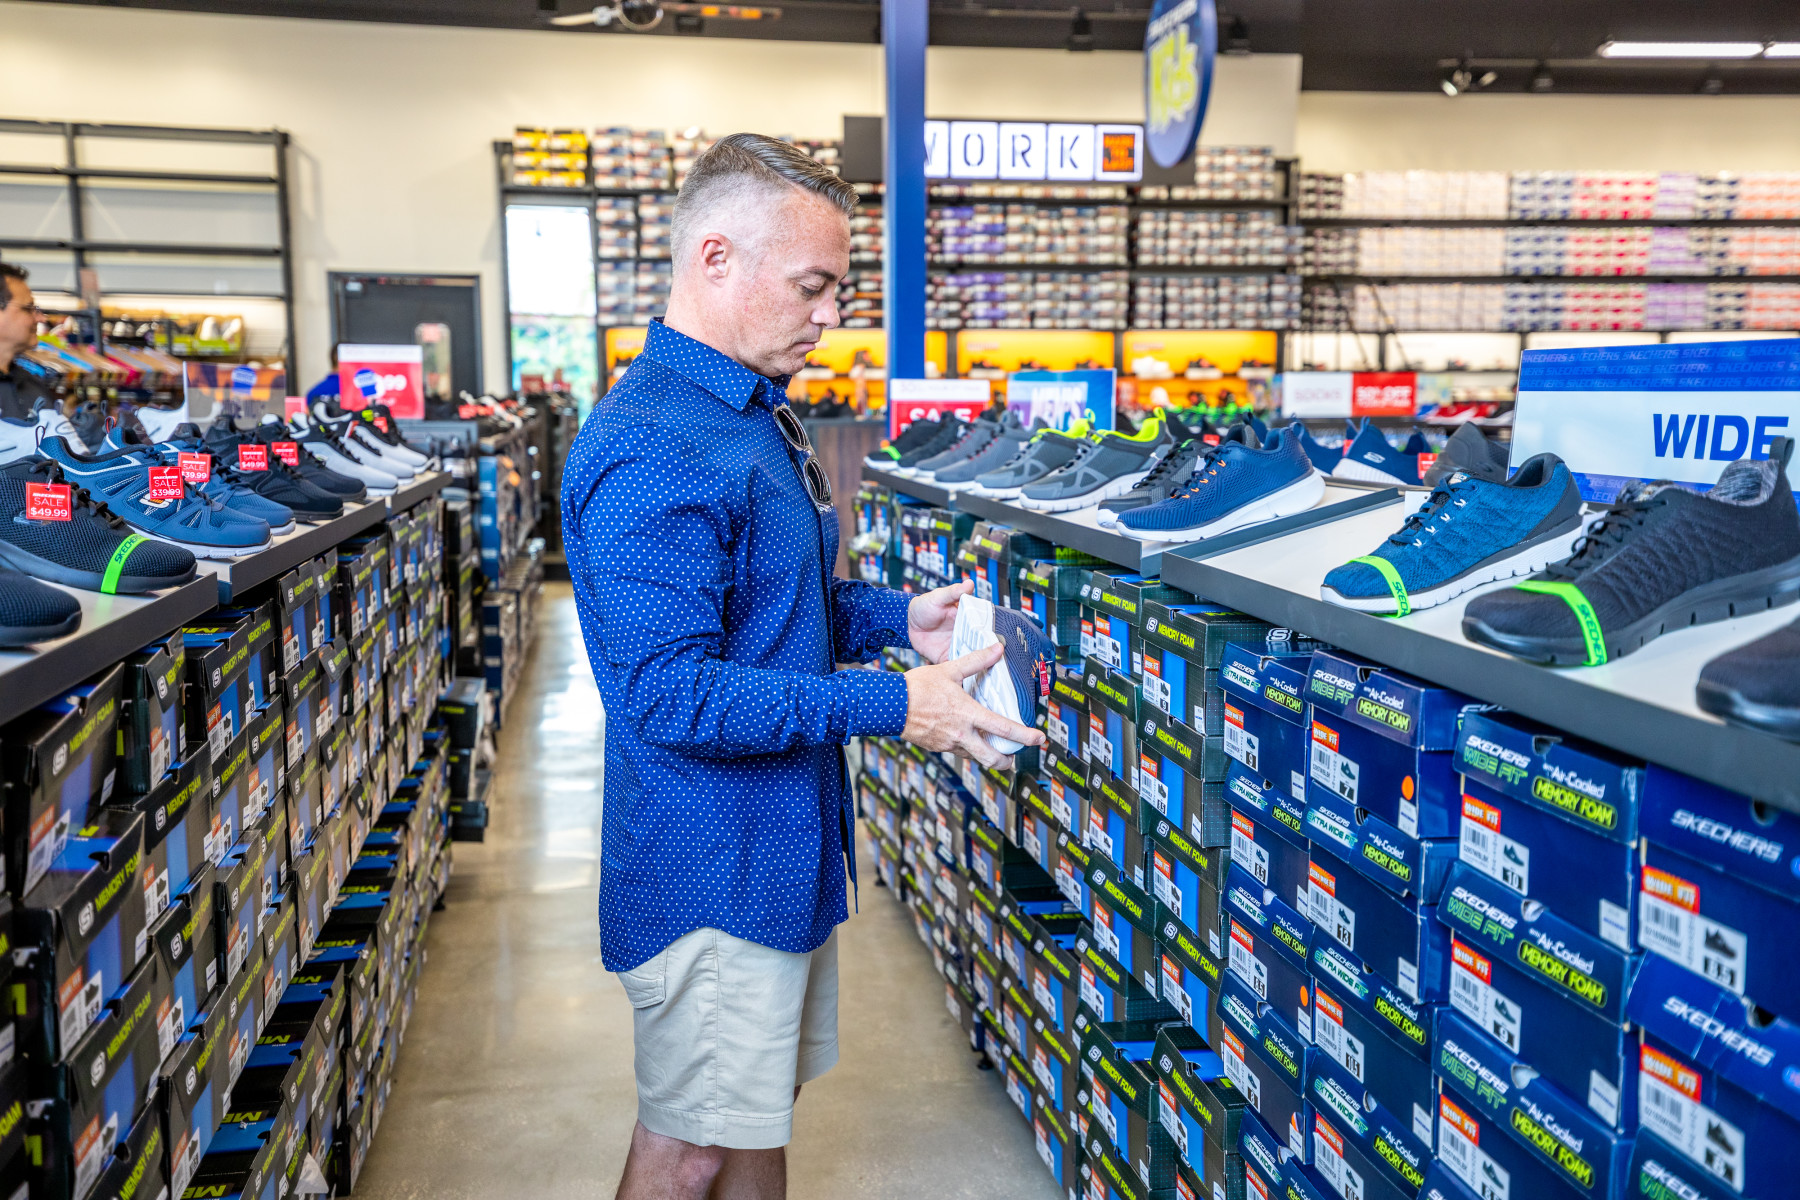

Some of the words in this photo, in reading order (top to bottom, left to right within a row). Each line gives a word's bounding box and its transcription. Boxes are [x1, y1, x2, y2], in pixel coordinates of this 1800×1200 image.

[1653, 413, 1789, 461] WIDE
[34, 498, 63, 507] SALE
[152, 489, 181, 497] $39.99
[30, 507, 67, 517] $49.99
[1102, 592, 1121, 608] MEMORY
[1122, 599, 1136, 614] FOAM
[248, 627, 261, 643] MEMORY
[261, 619, 271, 634] FOAM
[1158, 623, 1180, 641] MEMORY
[1180, 634, 1194, 649] FOAM
[222, 656, 237, 676] MEMORY
[237, 645, 248, 661] FOAM
[1232, 661, 1256, 676] SKECHERS
[1097, 680, 1114, 698] MEMORY
[1115, 691, 1128, 706] FOAM
[1273, 678, 1297, 695] Air-Cooled
[1311, 678, 1335, 700] WIDE
[1335, 689, 1354, 706] FIT
[1313, 669, 1356, 691] SKECHERS
[1266, 687, 1285, 705] MEMORY
[1286, 697, 1301, 712] FOAM
[1359, 699, 1386, 722] MEMORY
[1388, 712, 1409, 731] FOAM
[1369, 688, 1404, 710] Air-Cooled
[69, 718, 96, 754] MEMORY
[97, 698, 114, 726] FOAM
[259, 723, 273, 744] MEMORY
[272, 715, 281, 732] FOAM
[1156, 728, 1176, 748] MEMORY
[1177, 741, 1192, 759] FOAM
[1466, 735, 1531, 768] SKECHERS
[221, 761, 238, 785] MEMORY
[238, 747, 248, 767] FOAM
[1463, 746, 1498, 773] WIDE
[1498, 762, 1528, 786] FIT
[1551, 765, 1606, 799] Air-Cooled
[166, 792, 188, 816] MEMORY
[188, 775, 201, 797] FOAM
[1102, 783, 1118, 803] MEMORY
[1119, 798, 1132, 815] FOAM
[1239, 775, 1262, 793] SKECHERS
[1273, 807, 1291, 826] MEMORY
[1318, 806, 1350, 827] SKECHERS
[1464, 802, 1485, 818] WIDE
[1536, 780, 1579, 812] MEMORY
[1580, 799, 1614, 827] FOAM
[1328, 820, 1345, 838] WIDE
[1671, 809, 1784, 864] SKECHERS
[1170, 830, 1191, 855] MEMORY
[1192, 848, 1208, 869] FOAM
[1365, 844, 1388, 868] MEMORY
[1389, 858, 1409, 879] FOAM
[1374, 835, 1404, 859] Air-Cooled
[95, 870, 126, 912] MEMORY
[1104, 879, 1125, 904] MEMORY
[1126, 897, 1142, 919] FOAM
[1238, 886, 1261, 907] SKECHERS
[1451, 886, 1518, 929] SKECHERS
[182, 913, 199, 941] MEMORY
[199, 892, 210, 920] FOAM
[1279, 916, 1303, 941] Air-Cooled
[1446, 897, 1481, 934] WIDE
[1482, 918, 1515, 945] FIT
[1177, 934, 1200, 962] MEMORY
[1200, 955, 1218, 980] FOAM
[1273, 923, 1292, 946] MEMORY
[1292, 938, 1306, 958] FOAM
[1454, 946, 1474, 966] WIDE
[1537, 932, 1594, 975] Air-Cooled
[1086, 947, 1106, 970] MEMORY
[1106, 964, 1120, 984] FOAM
[1327, 947, 1360, 975] SKECHERS
[1336, 967, 1354, 988] WIDE
[1522, 944, 1568, 982] MEMORY
[1569, 971, 1603, 1004] FOAM
[238, 973, 255, 1004] MEMORY
[254, 955, 263, 978] FOAM
[1231, 994, 1255, 1019] SKECHERS
[1376, 996, 1401, 1025] MEMORY
[1402, 1017, 1424, 1043] FOAM
[1386, 989, 1418, 1021] Air-Cooled
[106, 1017, 135, 1061] MEMORY
[135, 991, 151, 1023] FOAM
[1663, 996, 1775, 1067] SKECHERS
[196, 1037, 215, 1074] MEMORY
[215, 1015, 226, 1044] FOAM
[1264, 1038, 1284, 1063] MEMORY
[1284, 1056, 1298, 1077] FOAM
[1272, 1032, 1294, 1058] Air-Cooled
[1100, 1057, 1120, 1086] MEMORY
[1120, 1078, 1137, 1100] FOAM
[1441, 1050, 1476, 1090] WIDE
[1477, 1080, 1507, 1110] FIT
[1443, 1039, 1510, 1095] SKECHERS
[1172, 1069, 1194, 1102] MEMORY
[1194, 1096, 1212, 1124] FOAM
[1327, 1078, 1361, 1111] SKECHERS
[1336, 1097, 1354, 1121] WIDE
[1527, 1102, 1583, 1154] Air-Cooled
[119, 1158, 146, 1200] MEMORY
[146, 1127, 160, 1163] FOAM
[1252, 1135, 1276, 1164] SKECHERS
[1375, 1137, 1401, 1166] MEMORY
[1402, 1158, 1424, 1188] FOAM
[1386, 1129, 1418, 1167] Air-Cooled
[1514, 1111, 1557, 1156] MEMORY
[1558, 1147, 1591, 1185] FOAM
[1101, 1154, 1121, 1185] MEMORY
[1121, 1177, 1137, 1200] FOAM
